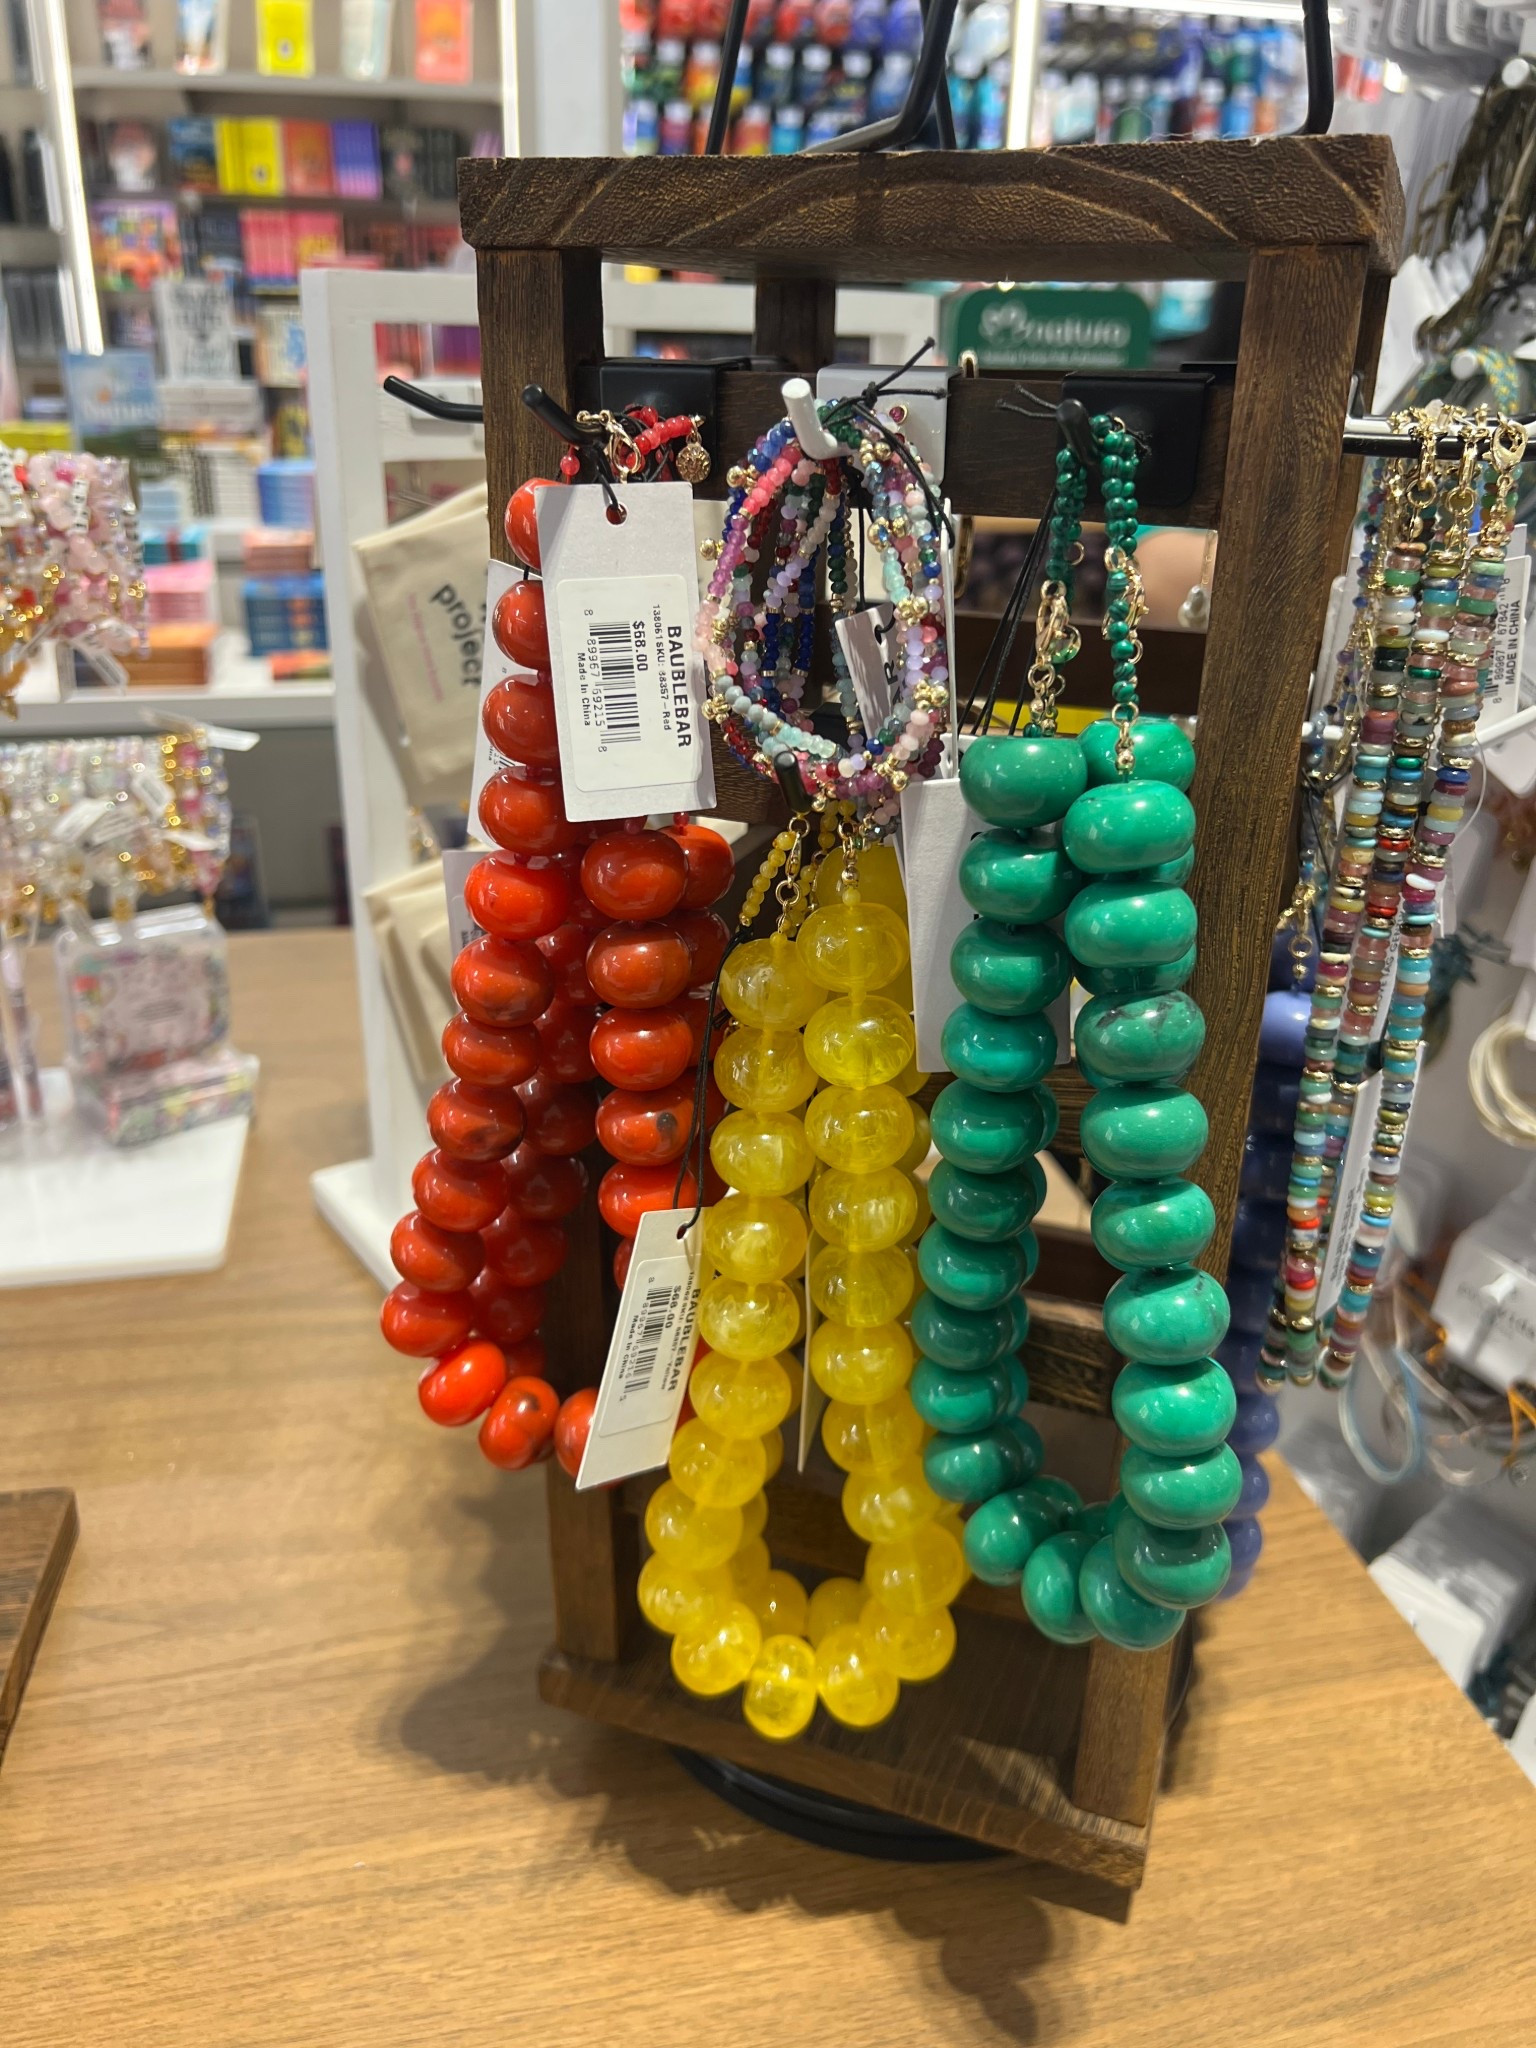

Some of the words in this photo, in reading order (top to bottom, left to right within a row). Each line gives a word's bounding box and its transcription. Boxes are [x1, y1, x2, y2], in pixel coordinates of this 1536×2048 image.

[1508, 600, 1520, 636] CHINA
[587, 638, 600, 678] 89967
[632, 620, 649, 672] $68.00
[1507, 638, 1518, 650] IN
[577, 652, 587, 680] Made
[1494, 650, 1505, 680] 89967
[1505, 652, 1517, 685] MADE
[580, 683, 589, 694] In
[667, 625, 692, 748] BAUBLEBAR
[582, 697, 591, 726] China
[592, 688, 605, 727] 69215
[662, 711, 672, 731] Red
[597, 745, 608, 753] 8
[665, 1285, 682, 1329] $68.00
[629, 1315, 639, 1339] Made
[667, 1288, 702, 1391] BAUBLEBAR
[618, 1354, 629, 1379] China
